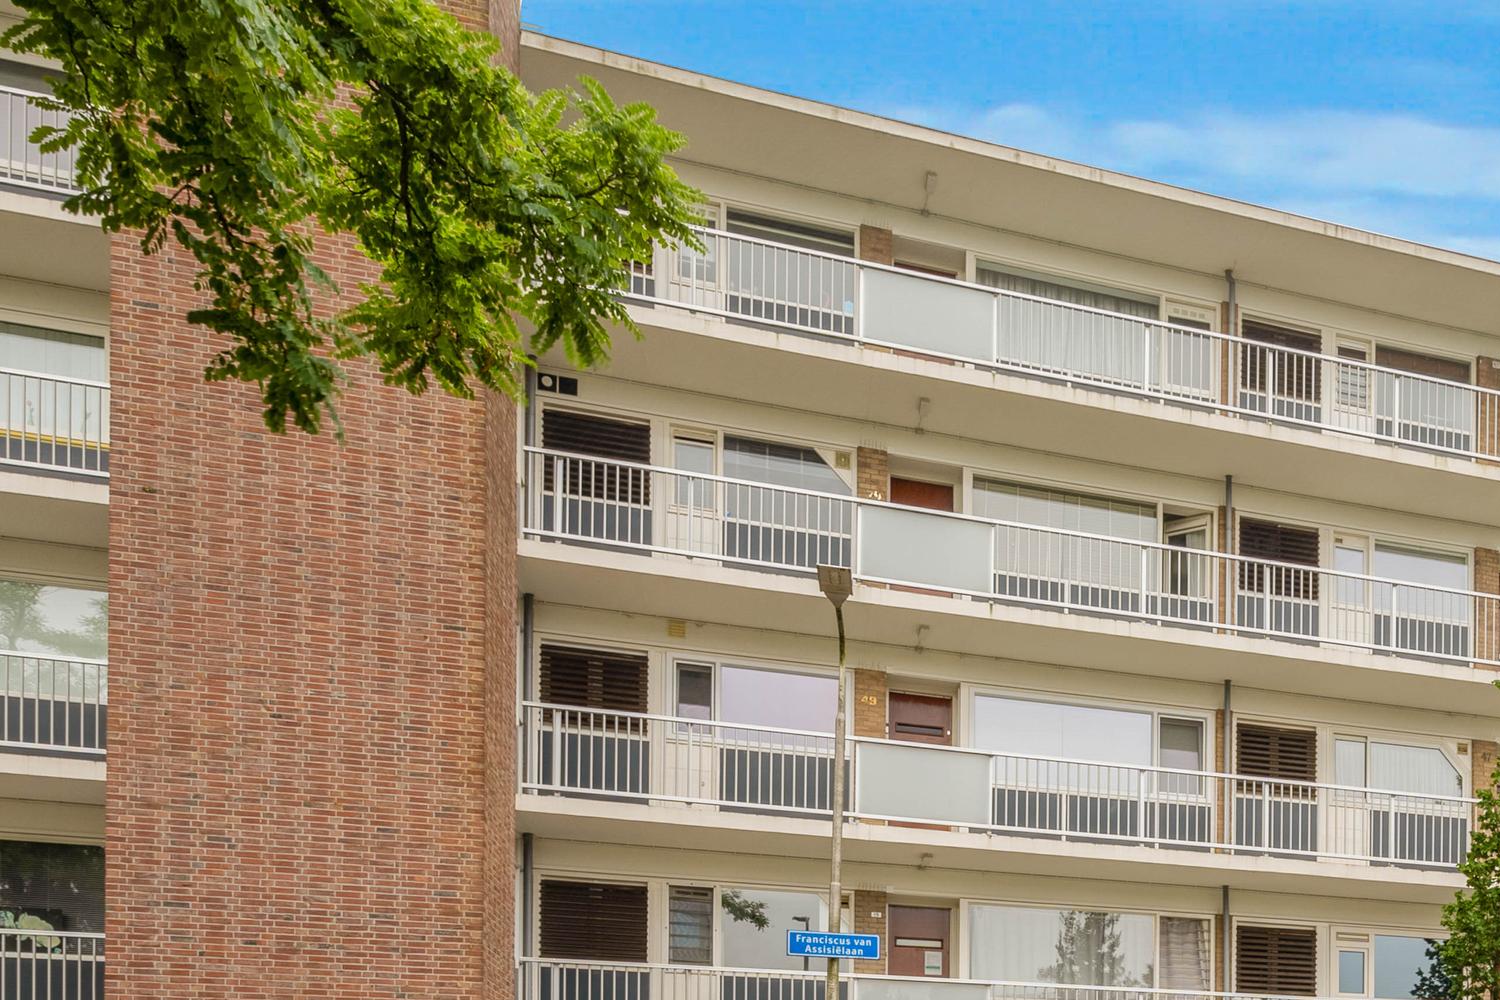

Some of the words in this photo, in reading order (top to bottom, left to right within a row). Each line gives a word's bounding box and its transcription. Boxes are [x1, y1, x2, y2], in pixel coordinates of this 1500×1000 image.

[795, 934, 851, 945] Franciscus
[854, 938, 872, 946] van
[804, 945, 864, 956] Assisiëlaan
